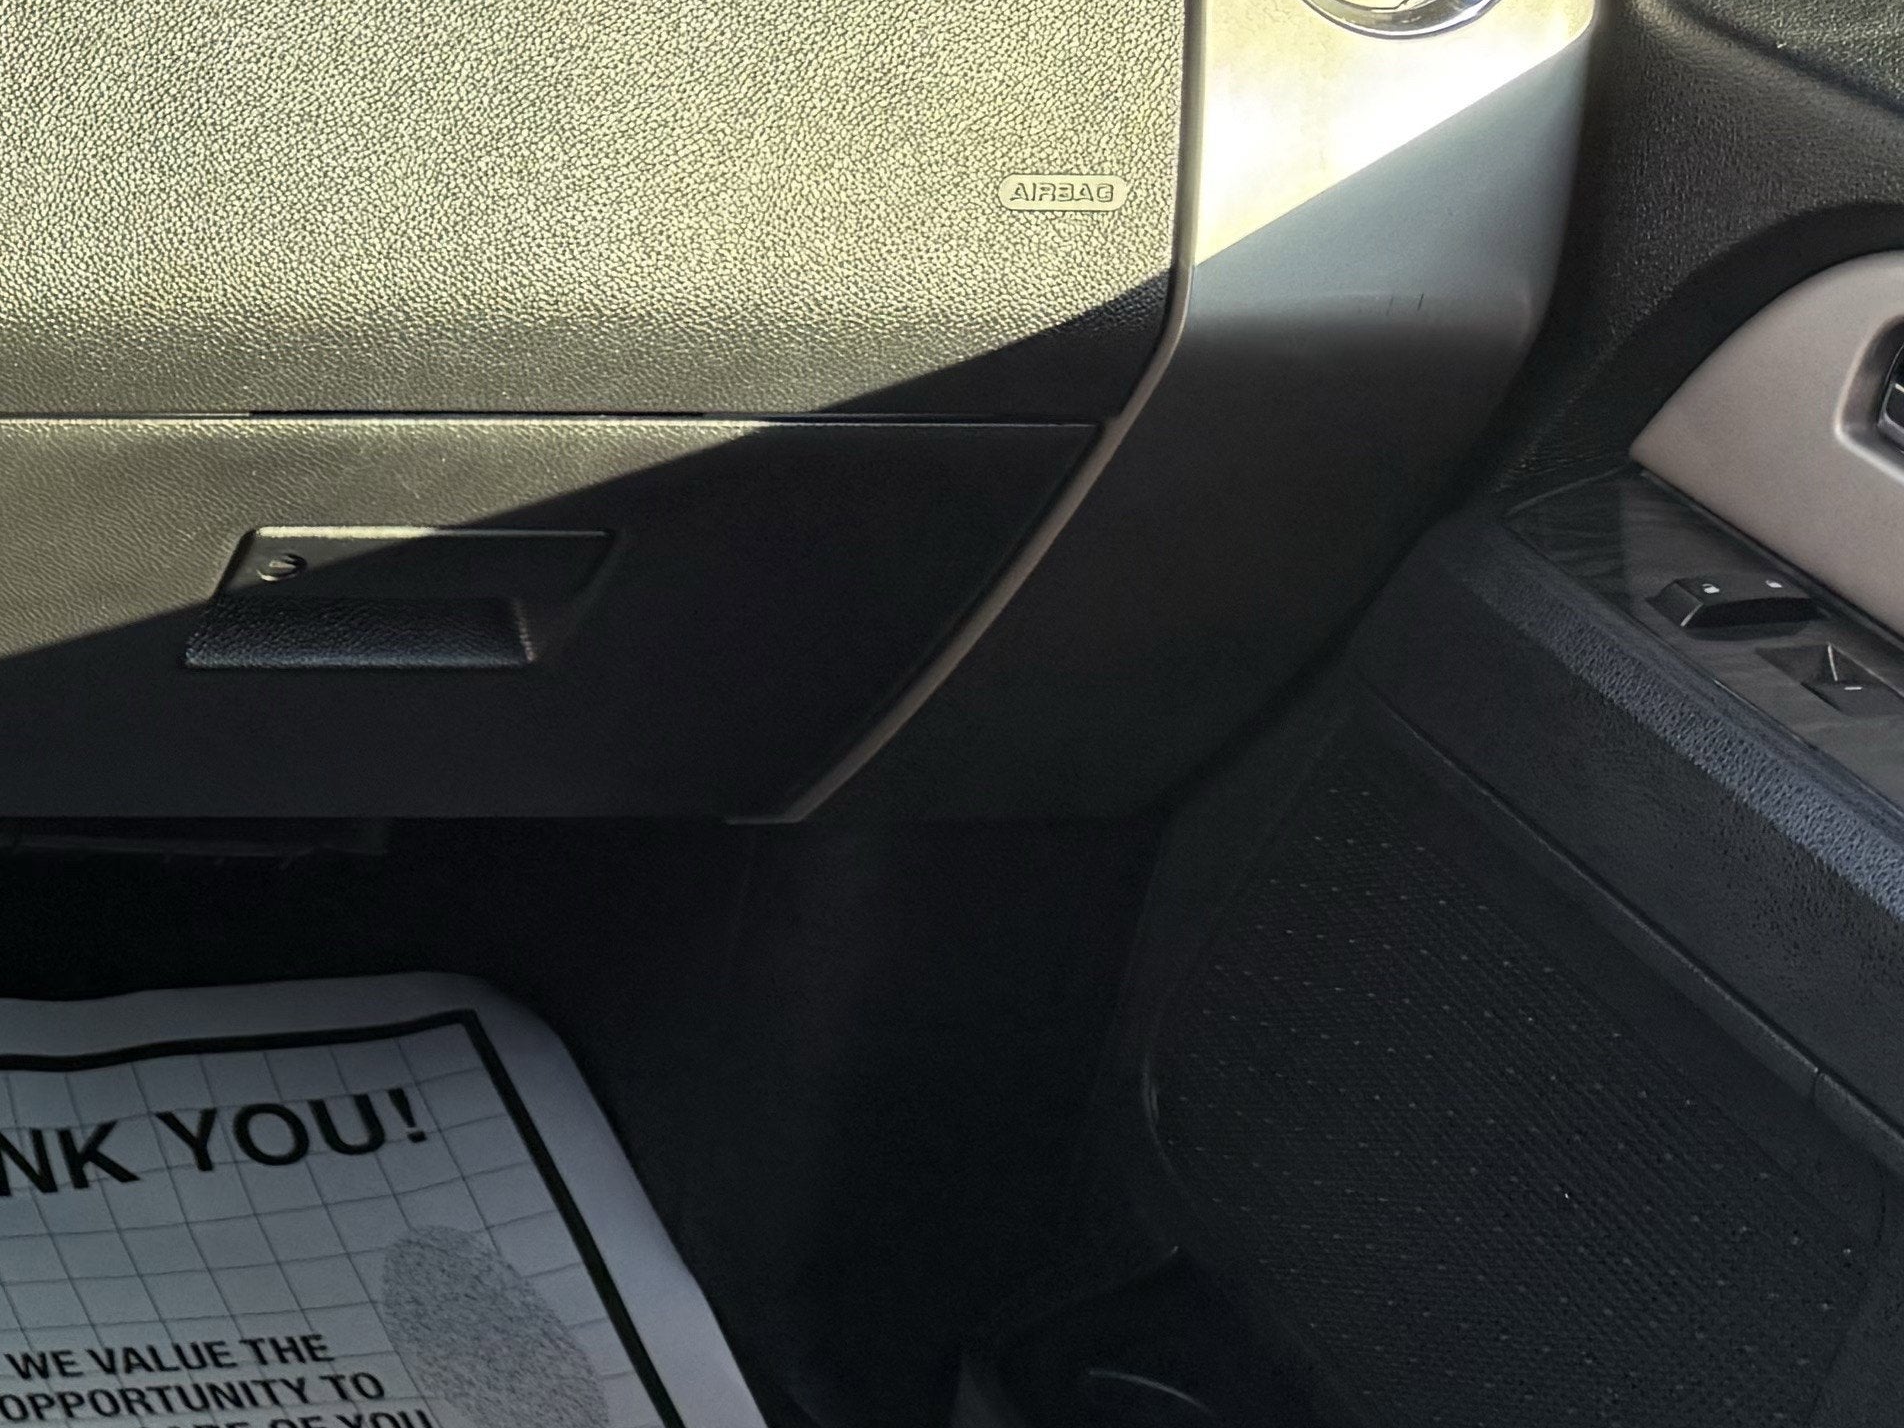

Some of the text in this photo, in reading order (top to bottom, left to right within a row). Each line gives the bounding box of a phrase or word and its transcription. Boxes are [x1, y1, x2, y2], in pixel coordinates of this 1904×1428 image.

[1009, 182, 1116, 203] AIRBAG
[155, 1087, 427, 1173] YOU!
[4, 1332, 334, 1380] WE VALUE THE
[319, 1371, 385, 1401] TO
